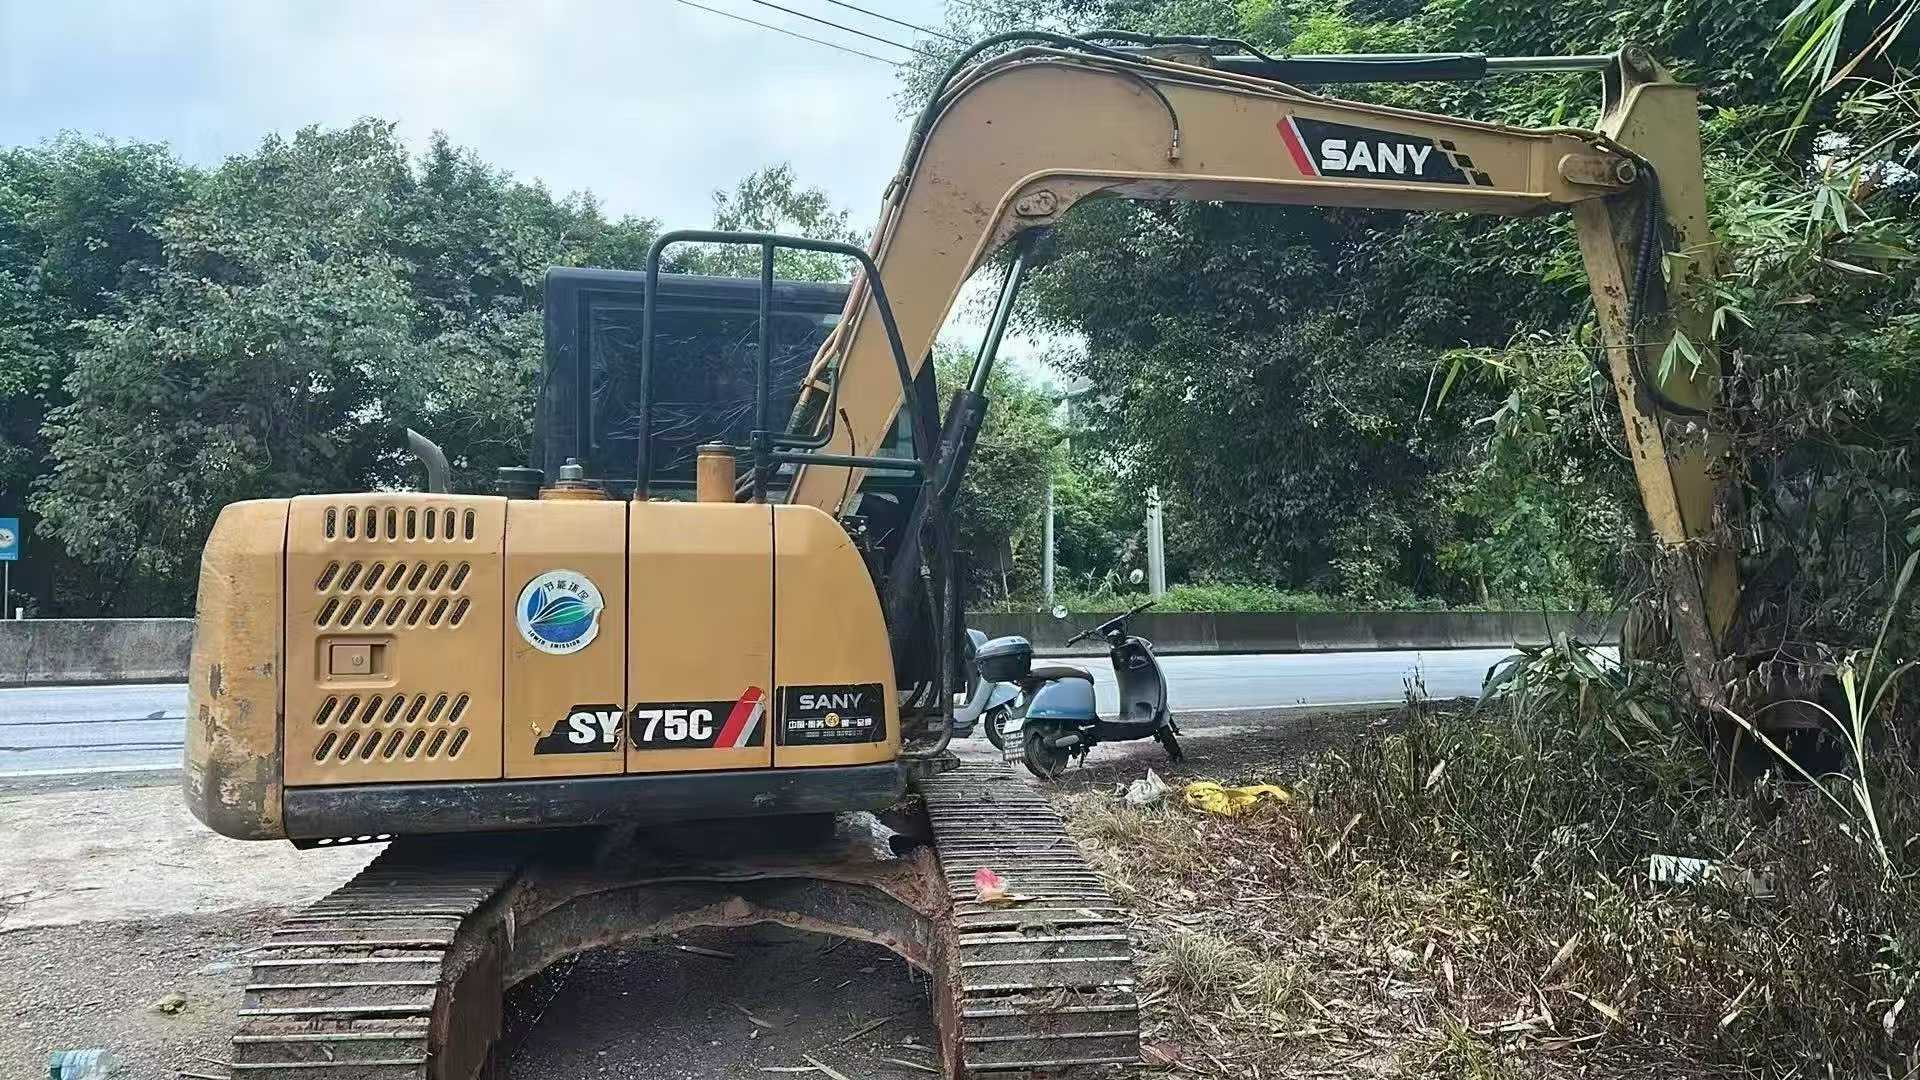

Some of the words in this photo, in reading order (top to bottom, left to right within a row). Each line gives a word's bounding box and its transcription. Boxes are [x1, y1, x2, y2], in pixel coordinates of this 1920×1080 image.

[1321, 139, 1433, 175] SANY
[799, 692, 863, 710] SANY
[638, 708, 713, 742] 75C
